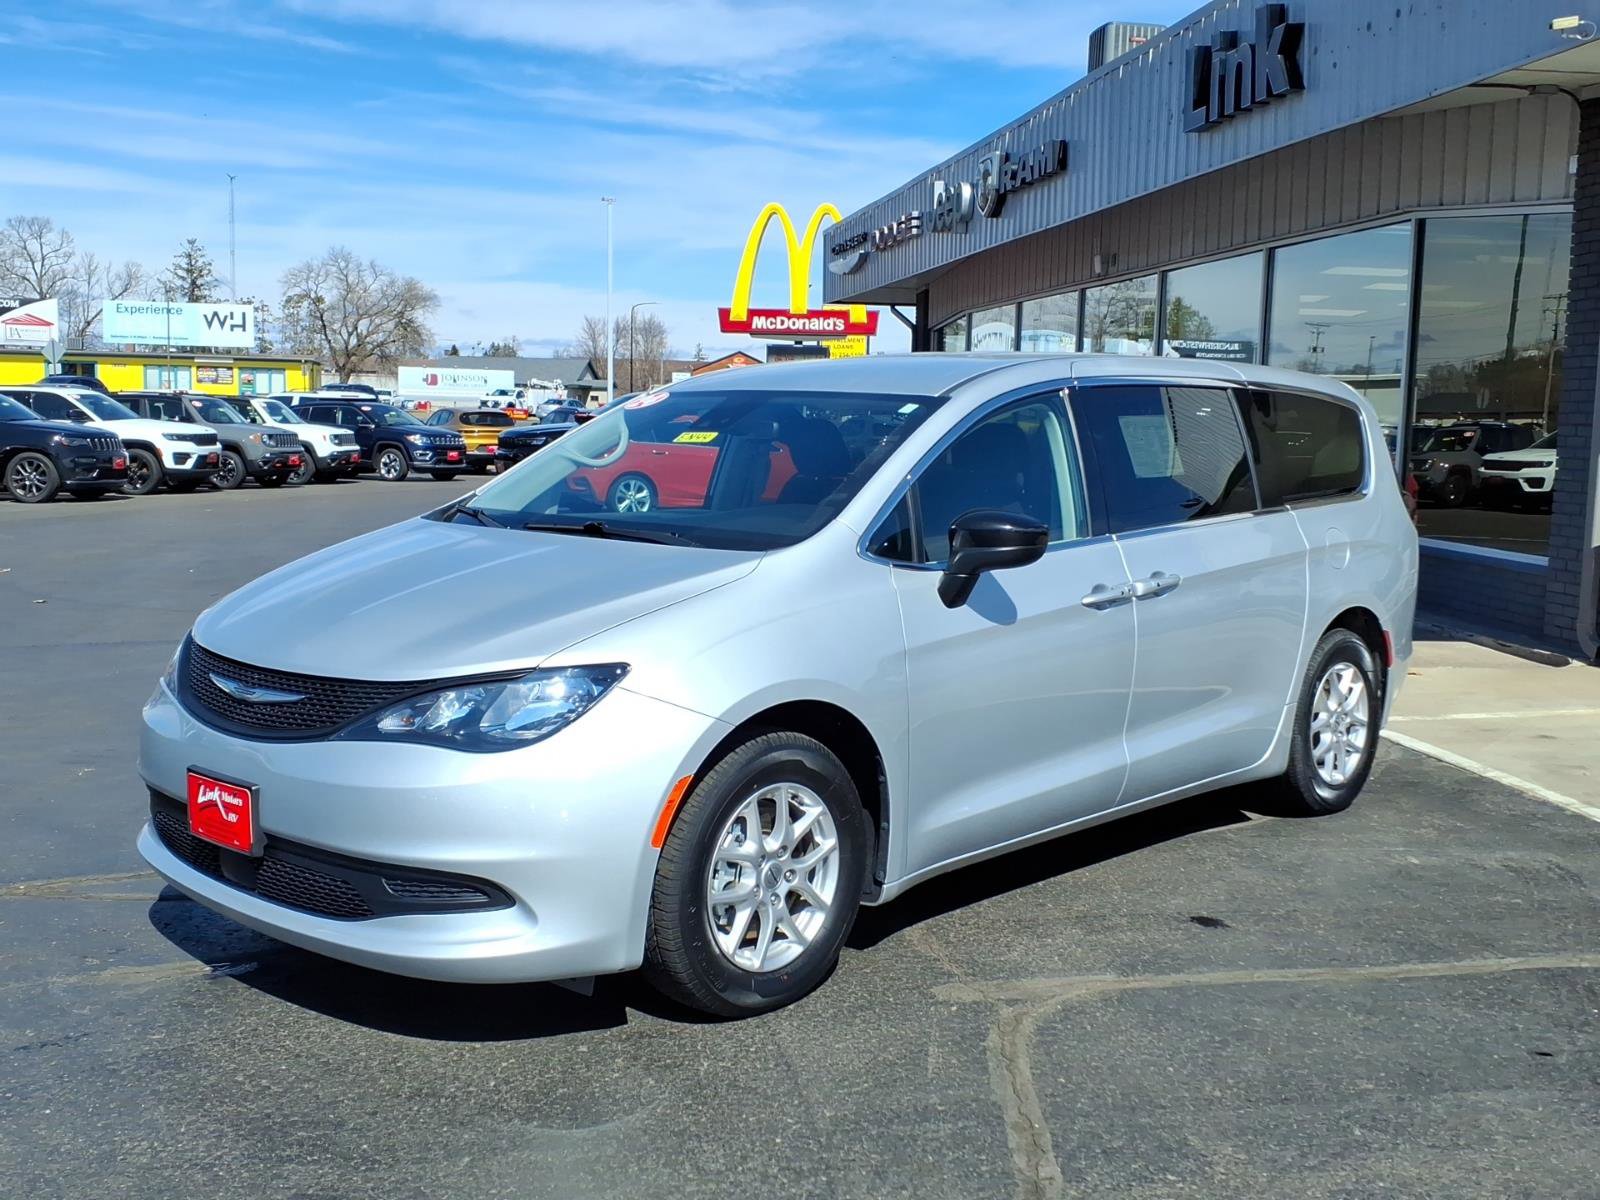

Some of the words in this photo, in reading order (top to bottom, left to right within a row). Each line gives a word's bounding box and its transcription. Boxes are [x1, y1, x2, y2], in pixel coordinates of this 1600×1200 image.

[1184, 4, 1306, 132] Link
[999, 139, 1067, 194] RAM
[116, 303, 183, 316] Experience
[203, 311, 246, 332] WH
[751, 316, 845, 330] McDonald's
[221, 791, 243, 807] Motors
[227, 812, 239, 823] RV
